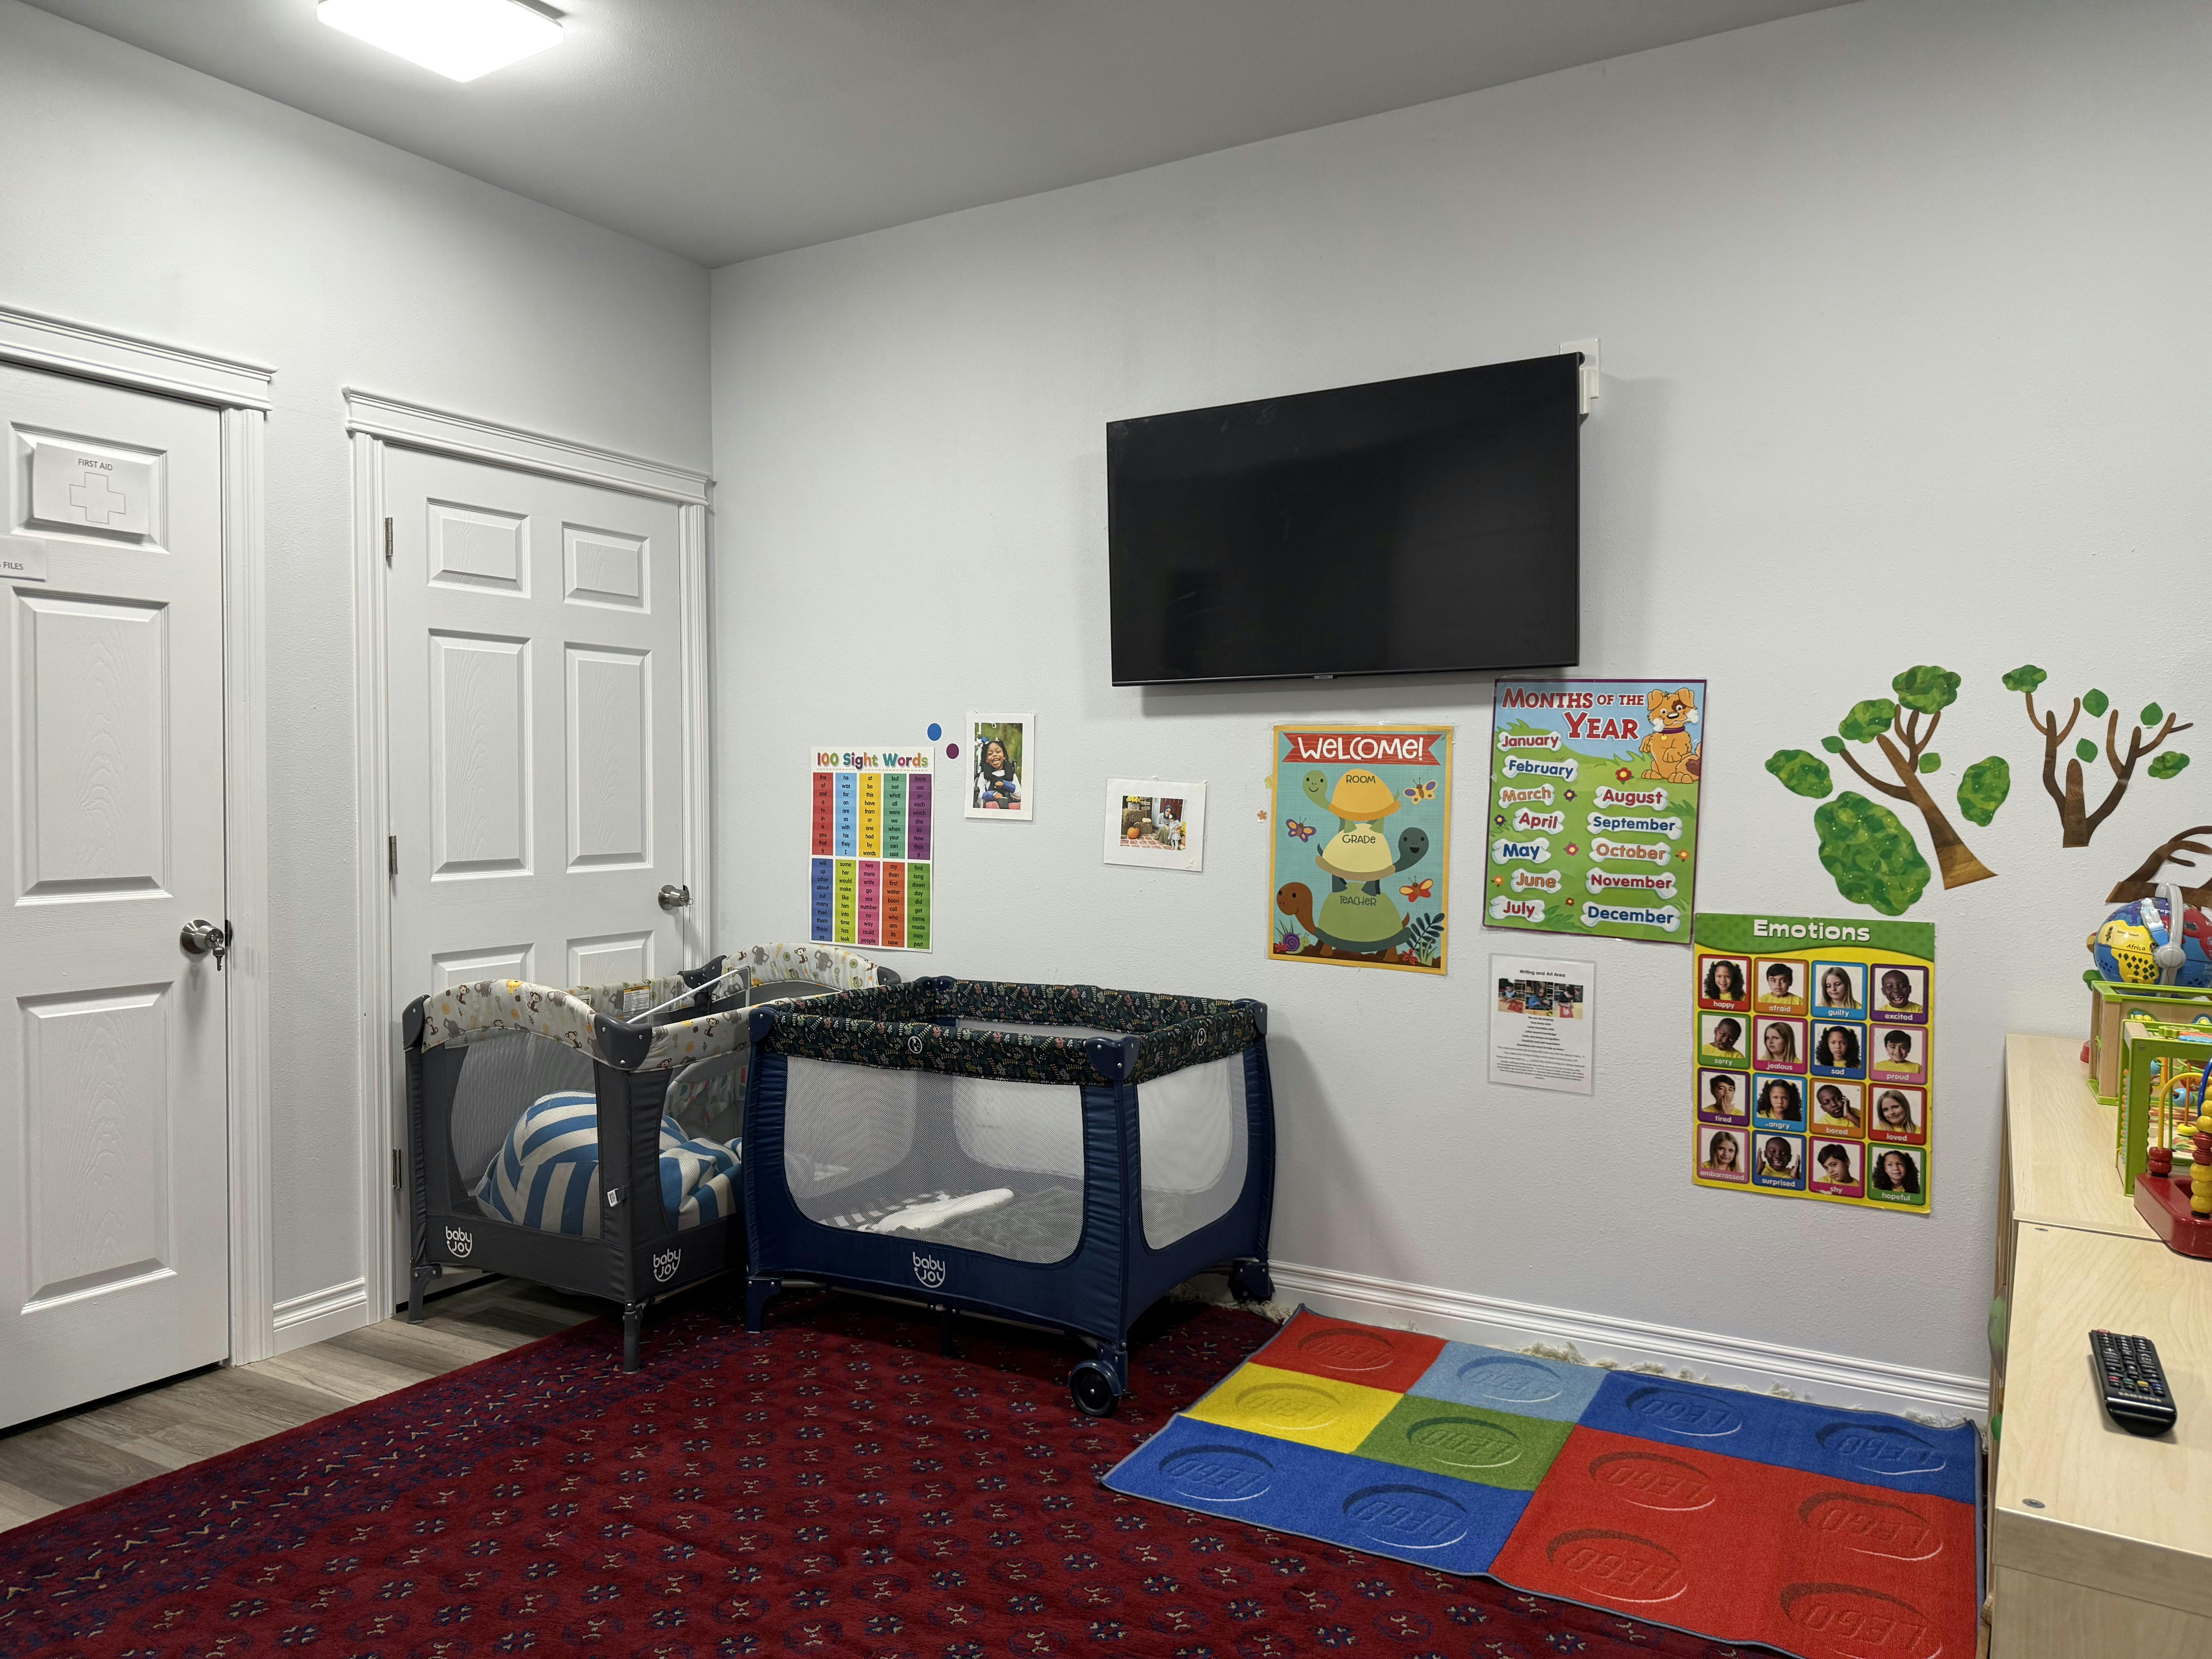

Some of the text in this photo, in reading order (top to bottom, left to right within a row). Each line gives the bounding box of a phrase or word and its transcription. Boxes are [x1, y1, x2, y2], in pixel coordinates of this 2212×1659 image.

[78, 459, 113, 471] FIRST AID
[3, 562, 24, 570] FILES
[1501, 687, 1645, 709] MONTHS OF THE
[1563, 711, 1639, 740] YEAR
[1501, 734, 1560, 748] January
[817, 752, 928, 769] 100 Sight Words
[1509, 759, 1574, 776] February
[1346, 775, 1376, 784] ROOM
[1502, 787, 1551, 801] March
[1602, 788, 1664, 806] August
[1519, 812, 1558, 830] April
[1593, 816, 1676, 831] September
[1503, 844, 1540, 859] May
[1596, 843, 1666, 860] October
[1515, 873, 1556, 888] June
[1591, 874, 1672, 889] November
[1503, 901, 1535, 919] July
[1587, 906, 1674, 924] December
[1753, 919, 1870, 941] Emotions
[1713, 1000, 1735, 1010] happy
[1769, 1004, 1791, 1012] afraid
[1828, 1008, 1850, 1018] guilty
[1884, 1012, 1913, 1021] excited
[1714, 1058, 1733, 1066] sorry
[1766, 1062, 1793, 1070] jealous
[1886, 1073, 1909, 1081] proud
[1769, 1121, 1790, 1130] angry
[1826, 1127, 1848, 1136] bored
[1886, 1133, 1908, 1142] loved
[1700, 1171, 1745, 1181] embarrassed
[1762, 1178, 1796, 1187] surprised
[1830, 1185, 1843, 1194] shy
[1882, 1192, 1911, 1202] hopeful
[445, 1226, 472, 1243] baby
[653, 1248, 681, 1269] baby
[913, 1252, 946, 1271] baby
[1304, 1341, 1387, 1365] LEGO
[1469, 1369, 1553, 1393] LEGO
[1245, 1396, 1331, 1420] LEGO
[1640, 1400, 1731, 1429] LEGO
[1420, 1430, 1516, 1458] LEGO
[1168, 1460, 1266, 1494] LEGO
[1604, 1466, 1708, 1501] LEGO
[1350, 1501, 1458, 1539] LEGO
[1817, 1509, 1932, 1551] LEGO
[1562, 1547, 1680, 1592] LEGO
[1802, 1604, 1927, 1656] LEGO
